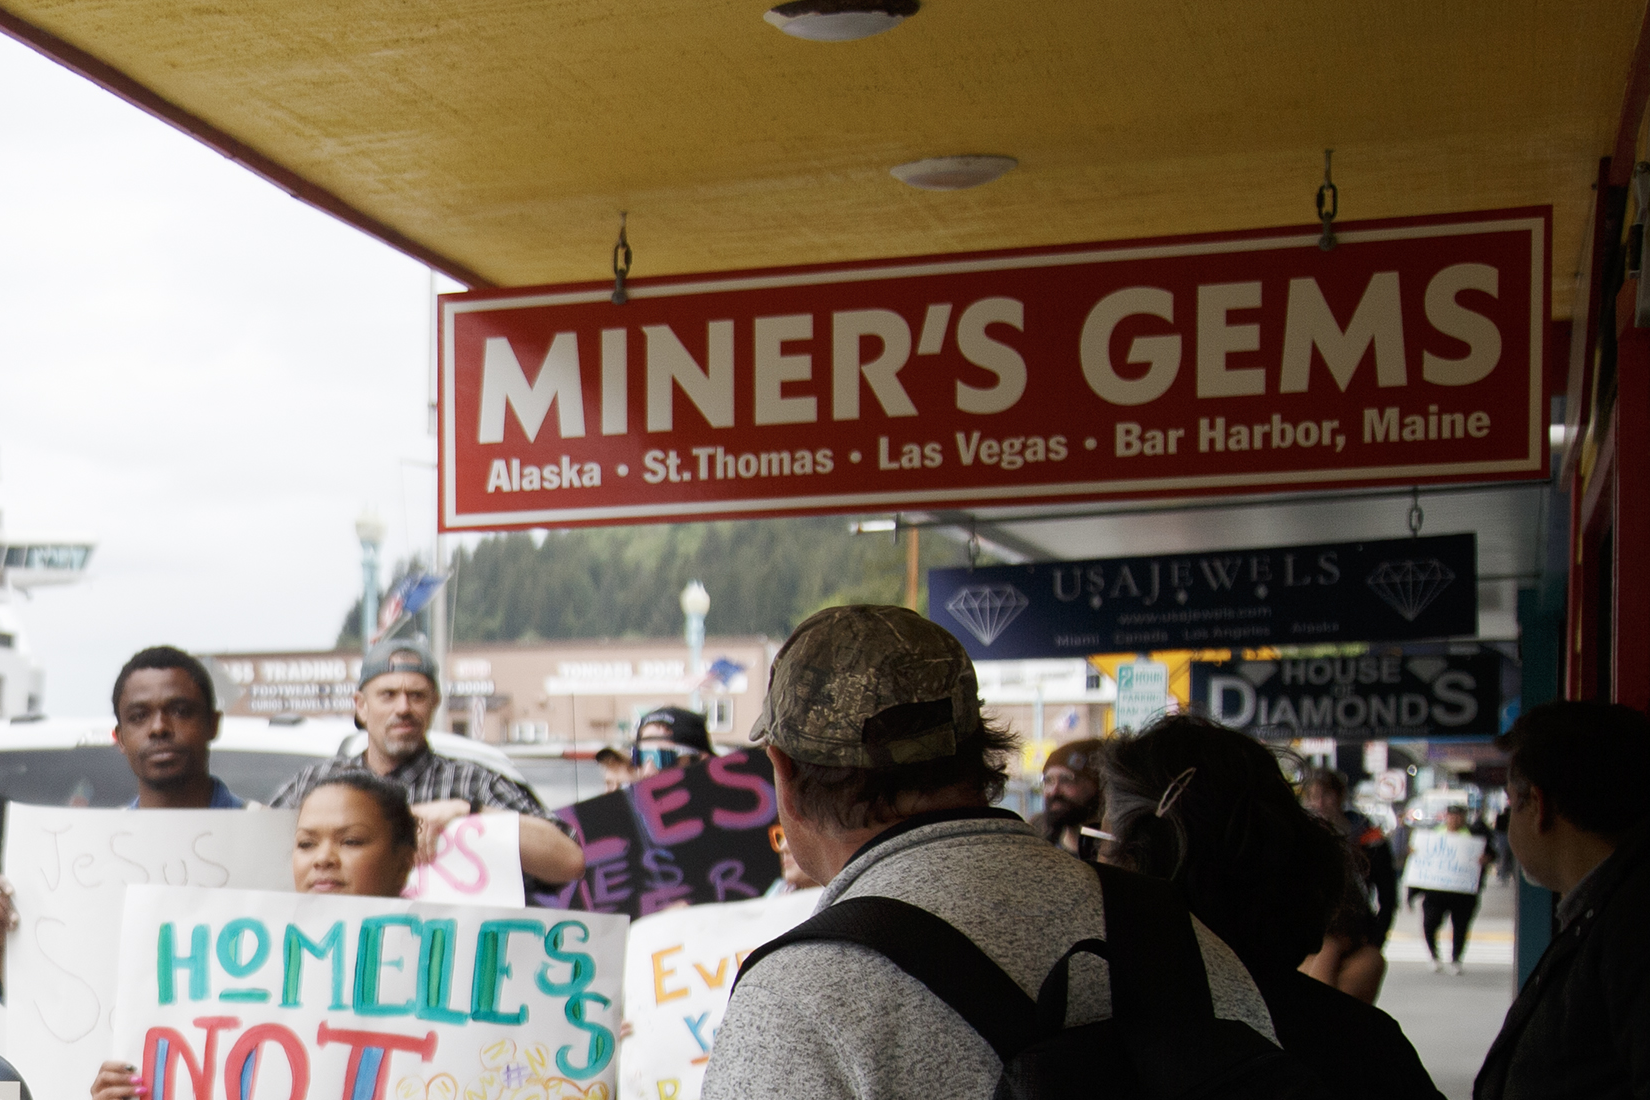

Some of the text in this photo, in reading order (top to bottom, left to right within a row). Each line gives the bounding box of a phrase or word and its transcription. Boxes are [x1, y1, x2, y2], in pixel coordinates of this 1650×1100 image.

[477, 261, 1502, 445] MINER'S GEMS
[487, 455, 602, 493] Alaska
[879, 436, 943, 471] Las
[955, 430, 1068, 470] Vegas
[1115, 422, 1184, 458] Bar
[1199, 413, 1346, 452] Harbor,
[1363, 405, 1491, 444] Maine
[1208, 668, 1480, 729] DIAMONDS
[1282, 657, 1401, 686] HOUSE
